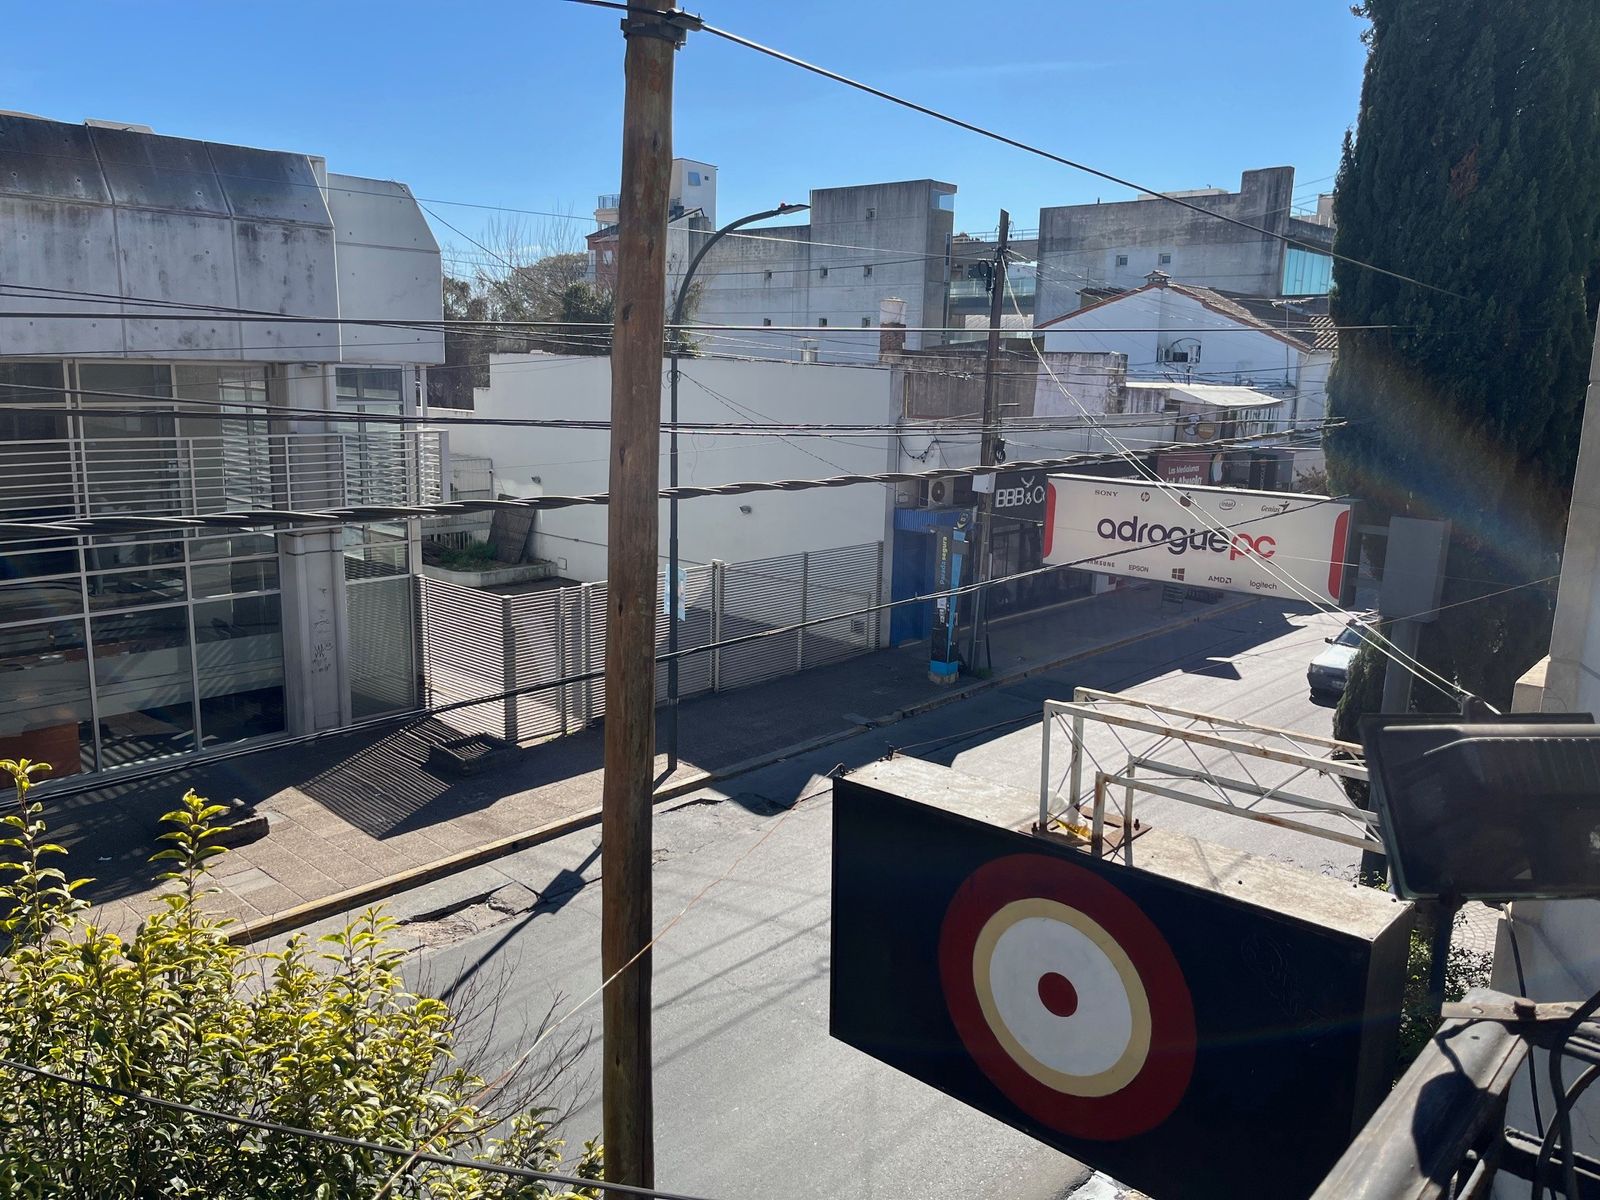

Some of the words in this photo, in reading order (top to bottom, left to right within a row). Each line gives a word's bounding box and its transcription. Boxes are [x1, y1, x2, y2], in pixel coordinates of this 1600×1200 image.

[1094, 489, 1119, 497] SONY
[1261, 504, 1281, 512] Genius
[1128, 564, 1149, 573] EPSON
[1208, 575, 1225, 583] AMD
[1249, 580, 1277, 590] logitech
